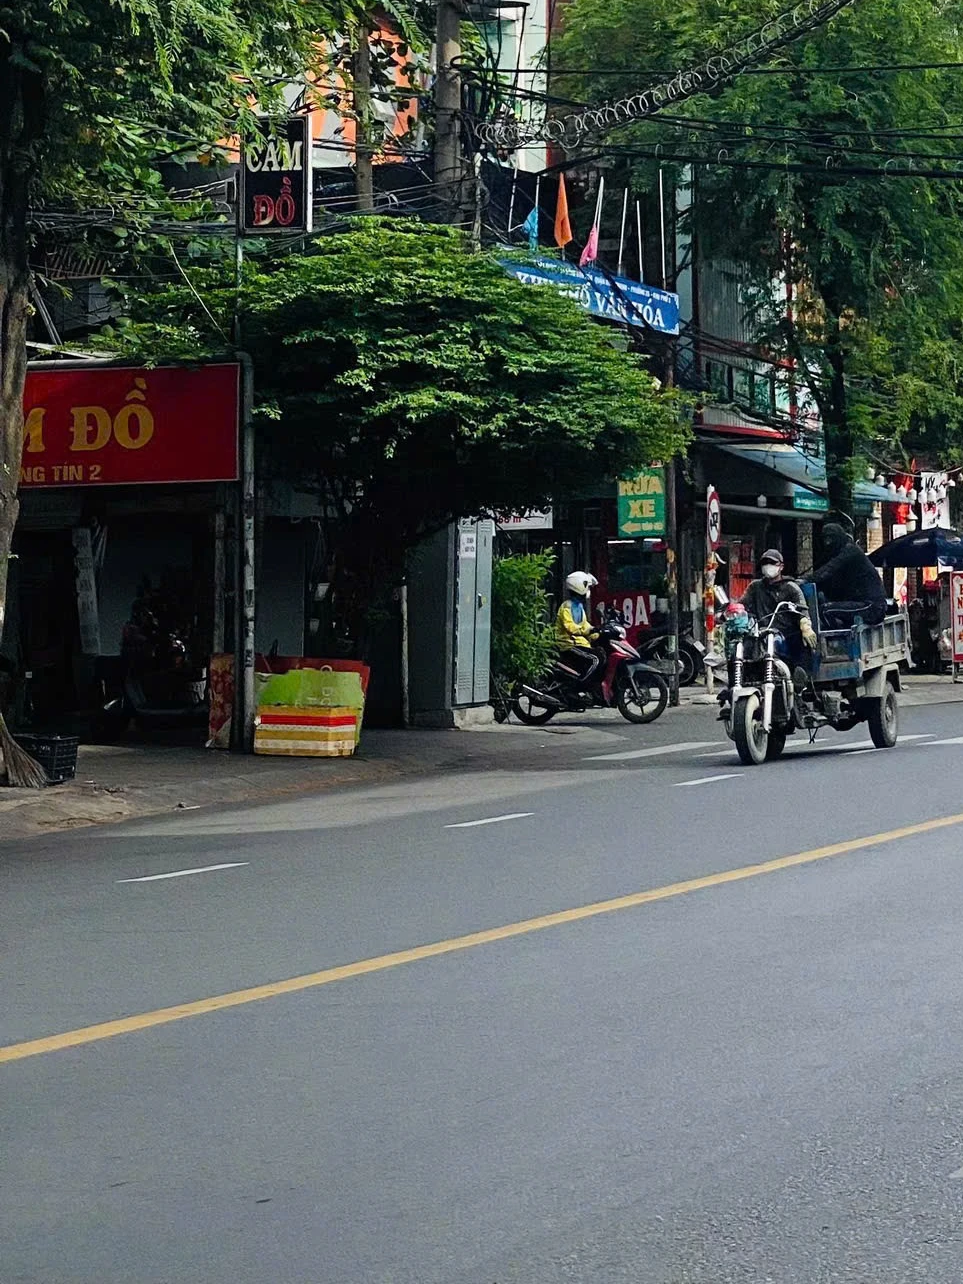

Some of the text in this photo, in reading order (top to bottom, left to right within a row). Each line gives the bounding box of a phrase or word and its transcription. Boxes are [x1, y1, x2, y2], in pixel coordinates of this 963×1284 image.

[253, 176, 295, 226] ĐỒ
[69, 377, 154, 451] ĐỒ
[20, 462, 102, 482] NG TÍN 2
[628, 499, 656, 518] XE
